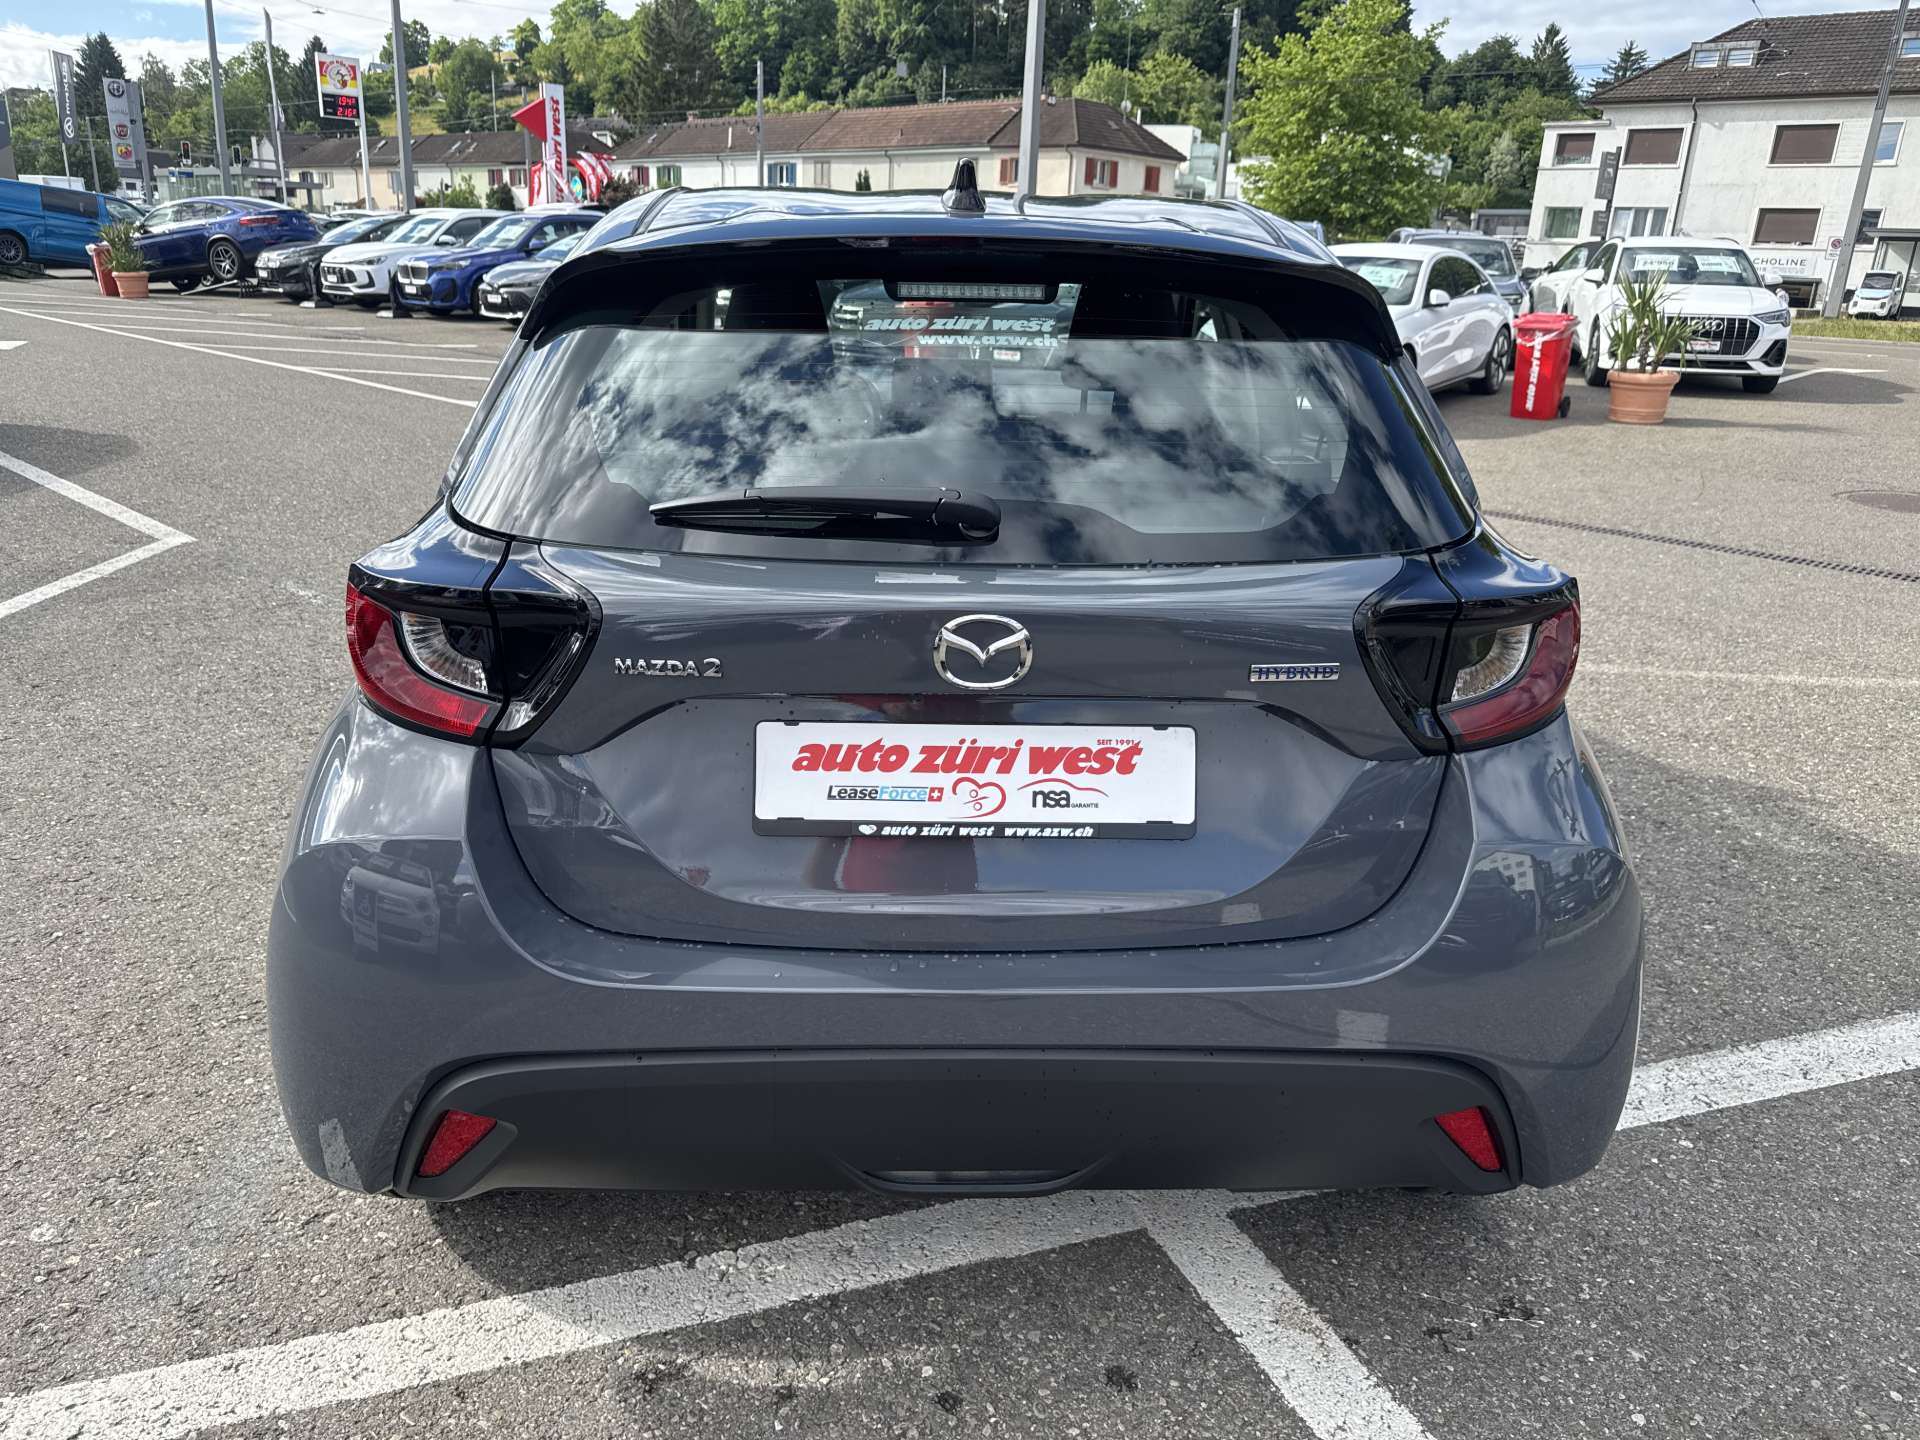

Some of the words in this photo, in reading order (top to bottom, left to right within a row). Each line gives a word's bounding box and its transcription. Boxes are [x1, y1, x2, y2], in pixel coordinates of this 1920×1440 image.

[863, 317, 928, 331] auto
[928, 316, 990, 331] züri
[992, 318, 1056, 332] west
[917, 333, 1058, 347] www.azw.ch
[1257, 666, 1334, 680] HYBRID
[791, 737, 910, 773] auto
[910, 738, 1024, 774] züri
[1028, 740, 1143, 775] west
[827, 785, 928, 800] LeaseForce
[1032, 790, 1071, 808] nsa
[881, 824, 917, 836] auto
[920, 824, 955, 836] züri
[959, 825, 995, 837] west
[1004, 825, 1094, 837] www.azw.ch
